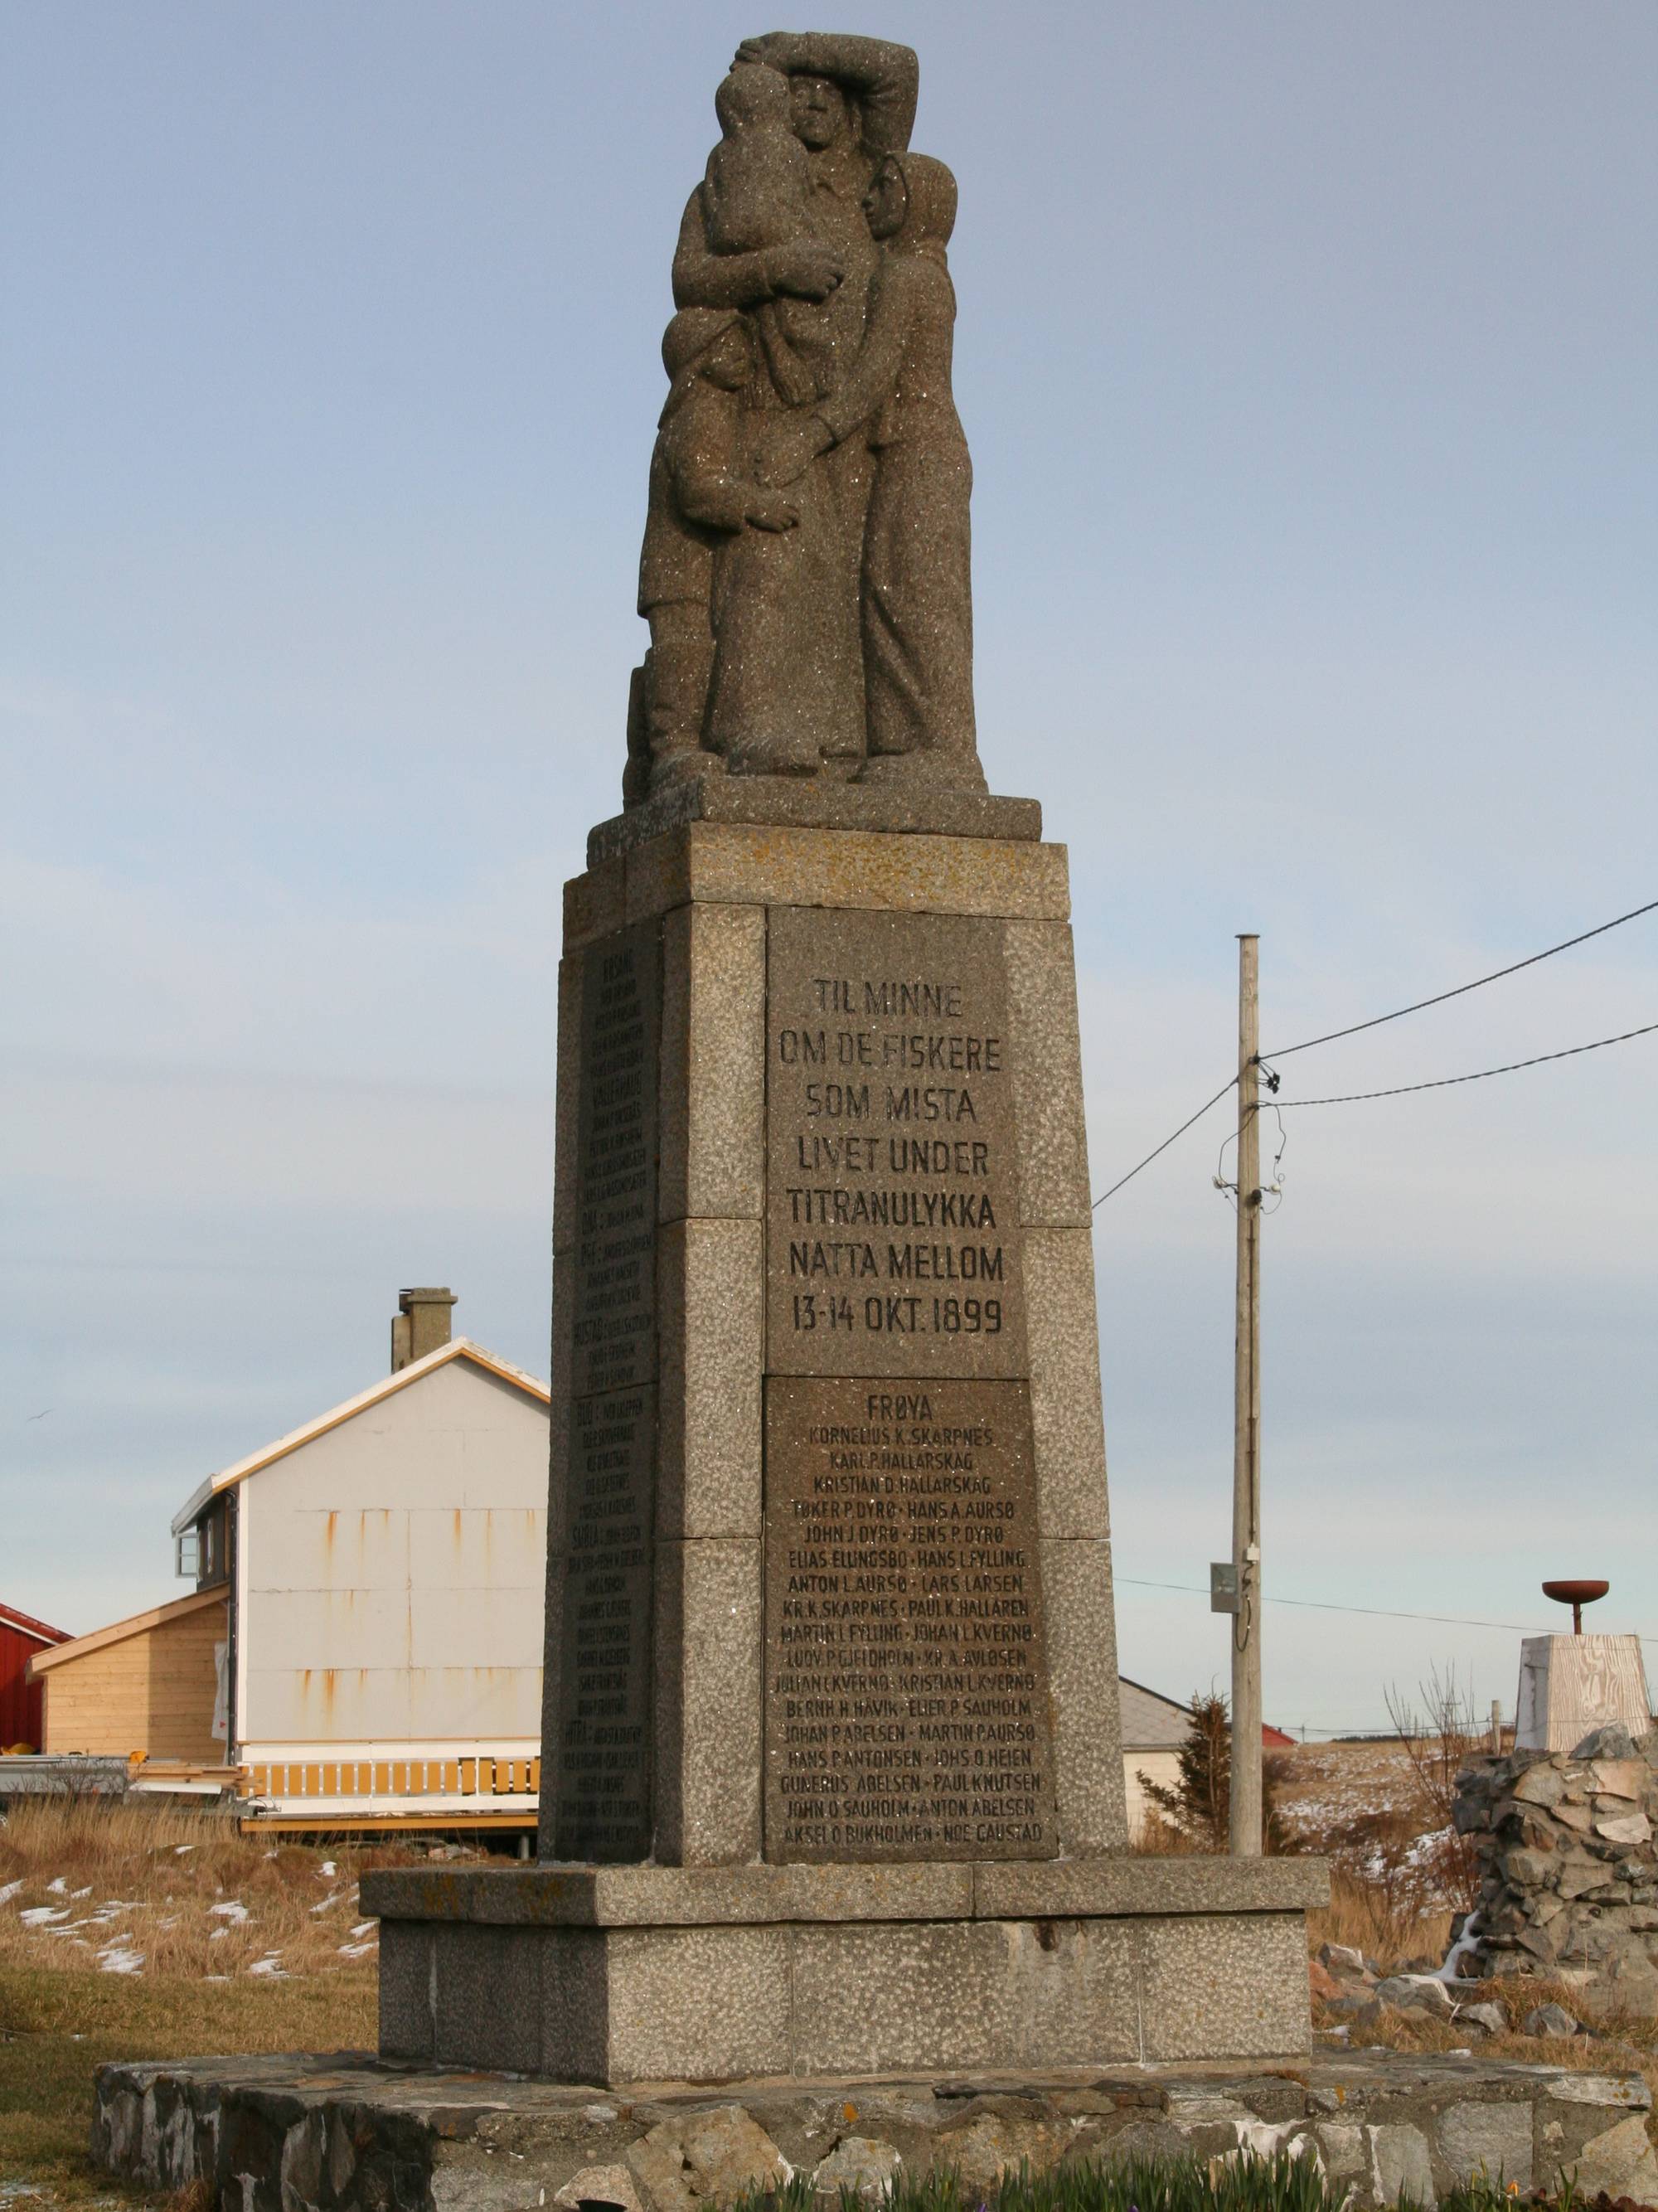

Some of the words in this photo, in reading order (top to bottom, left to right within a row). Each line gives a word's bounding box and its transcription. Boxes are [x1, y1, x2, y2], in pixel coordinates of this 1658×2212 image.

[814, 979, 855, 1014] TIL
[865, 982, 962, 1017] MINNE
[780, 1030, 826, 1065] OM
[838, 1032, 872, 1066] DE
[883, 1035, 1001, 1071] FISKERE
[807, 1084, 870, 1119] SOM
[886, 1087, 977, 1121] MISTA
[798, 1136, 879, 1171] LIVET
[890, 1138, 988, 1175] UNDER
[787, 1189, 996, 1229] TITRANULYKKA
[790, 1242, 879, 1278] NATTA
[888, 1244, 1003, 1282] MELLOM
[793, 1296, 855, 1332] 13-14
[865, 1297, 926, 1332] OKT.
[934, 1298, 1002, 1334] 1899
[868, 1395, 933, 1421] FRØYA
[809, 1427, 890, 1445] KORNELIUS
[912, 1428, 992, 1447] SKARPNES
[882, 1452, 973, 1471] HALLARSKAG
[814, 1476, 879, 1493] KRISTIAN
[900, 1476, 991, 1494] HALLARSKAG
[856, 1501, 895, 1519] DYRØ
[908, 1501, 948, 1519] HANS
[966, 1501, 1015, 1520] AURSØ
[804, 1526, 843, 1543] JOHN
[859, 1526, 899, 1544] DYRØ
[909, 1526, 947, 1544] JENS
[965, 1526, 1004, 1544] DYRØ
[789, 1550, 827, 1569] ELIAS
[918, 1550, 956, 1568] HANS
[970, 1550, 1025, 1569] FYLLING
[788, 1575, 838, 1594] ANTON
[922, 1575, 960, 1593] LARS
[965, 1575, 1023, 1594] LARSEN
[908, 1599, 943, 1618] PAUL
[781, 1624, 835, 1643] MARTIN
[913, 1623, 959, 1642] JOHAN
[784, 1724, 827, 1744] JOHAN
[919, 1724, 973, 1742] MARTIN
[788, 1750, 827, 1768] HANS
[844, 1749, 922, 1768] ANTONSEN
[933, 1774, 969, 1792] PAUL
[972, 1773, 1040, 1792] KNUTSEN
[787, 1800, 824, 1819] JOHN
[972, 1798, 1035, 1817] ABELSEN
